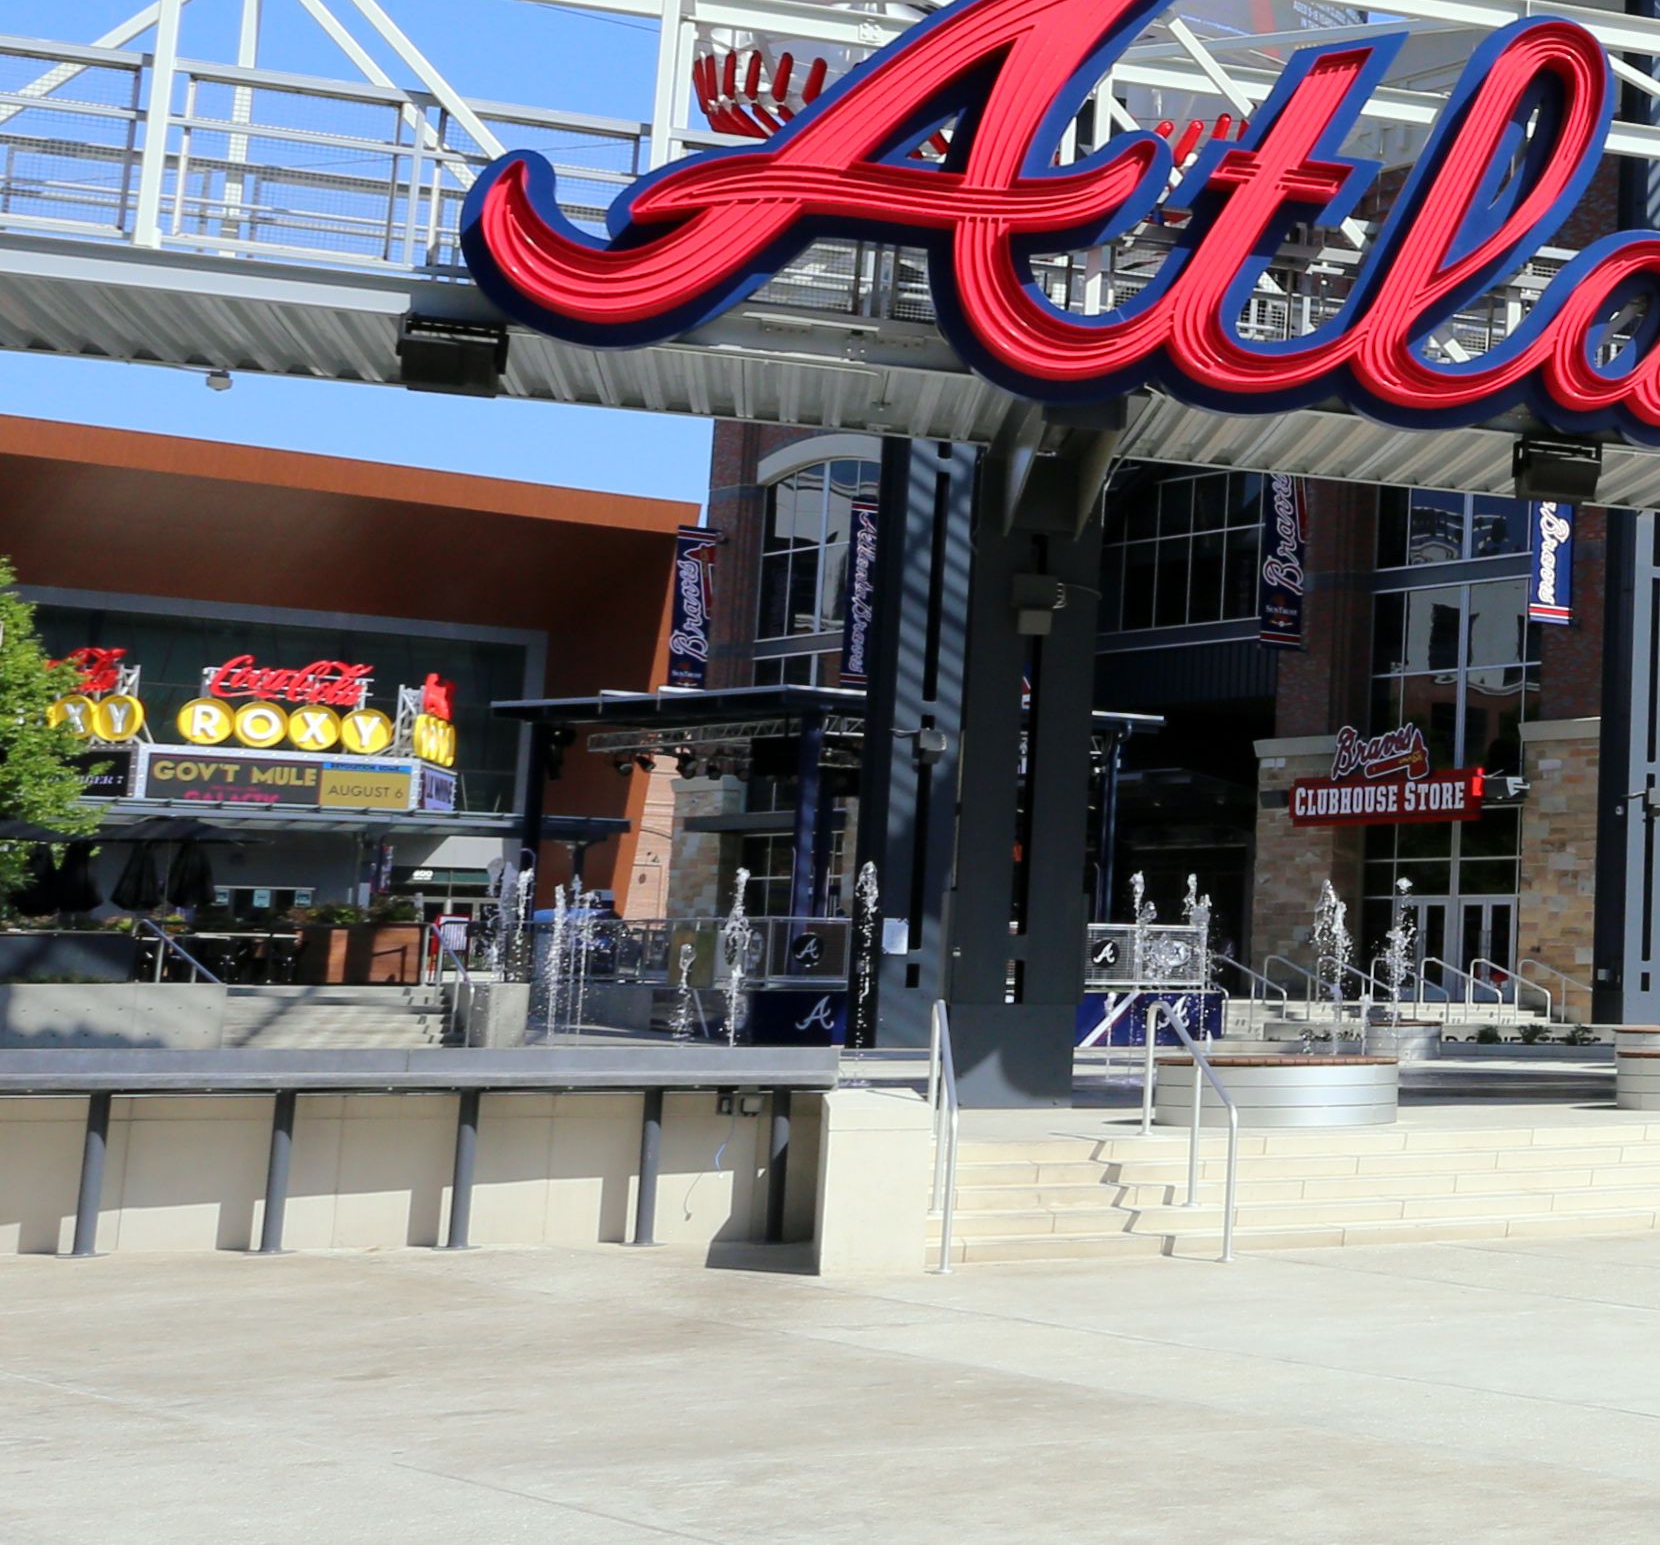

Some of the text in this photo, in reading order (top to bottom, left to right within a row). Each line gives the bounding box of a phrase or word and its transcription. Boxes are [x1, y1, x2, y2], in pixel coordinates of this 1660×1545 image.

[669, 559, 709, 662] Braves
[190, 703, 381, 747] ROXY
[1331, 722, 1413, 781] Braves
[152, 760, 318, 788] GOV'T MULE
[327, 784, 404, 799] AUGUST 6
[1295, 781, 1465, 816] CLUBHOUSE STORE
[795, 995, 835, 1030] A
